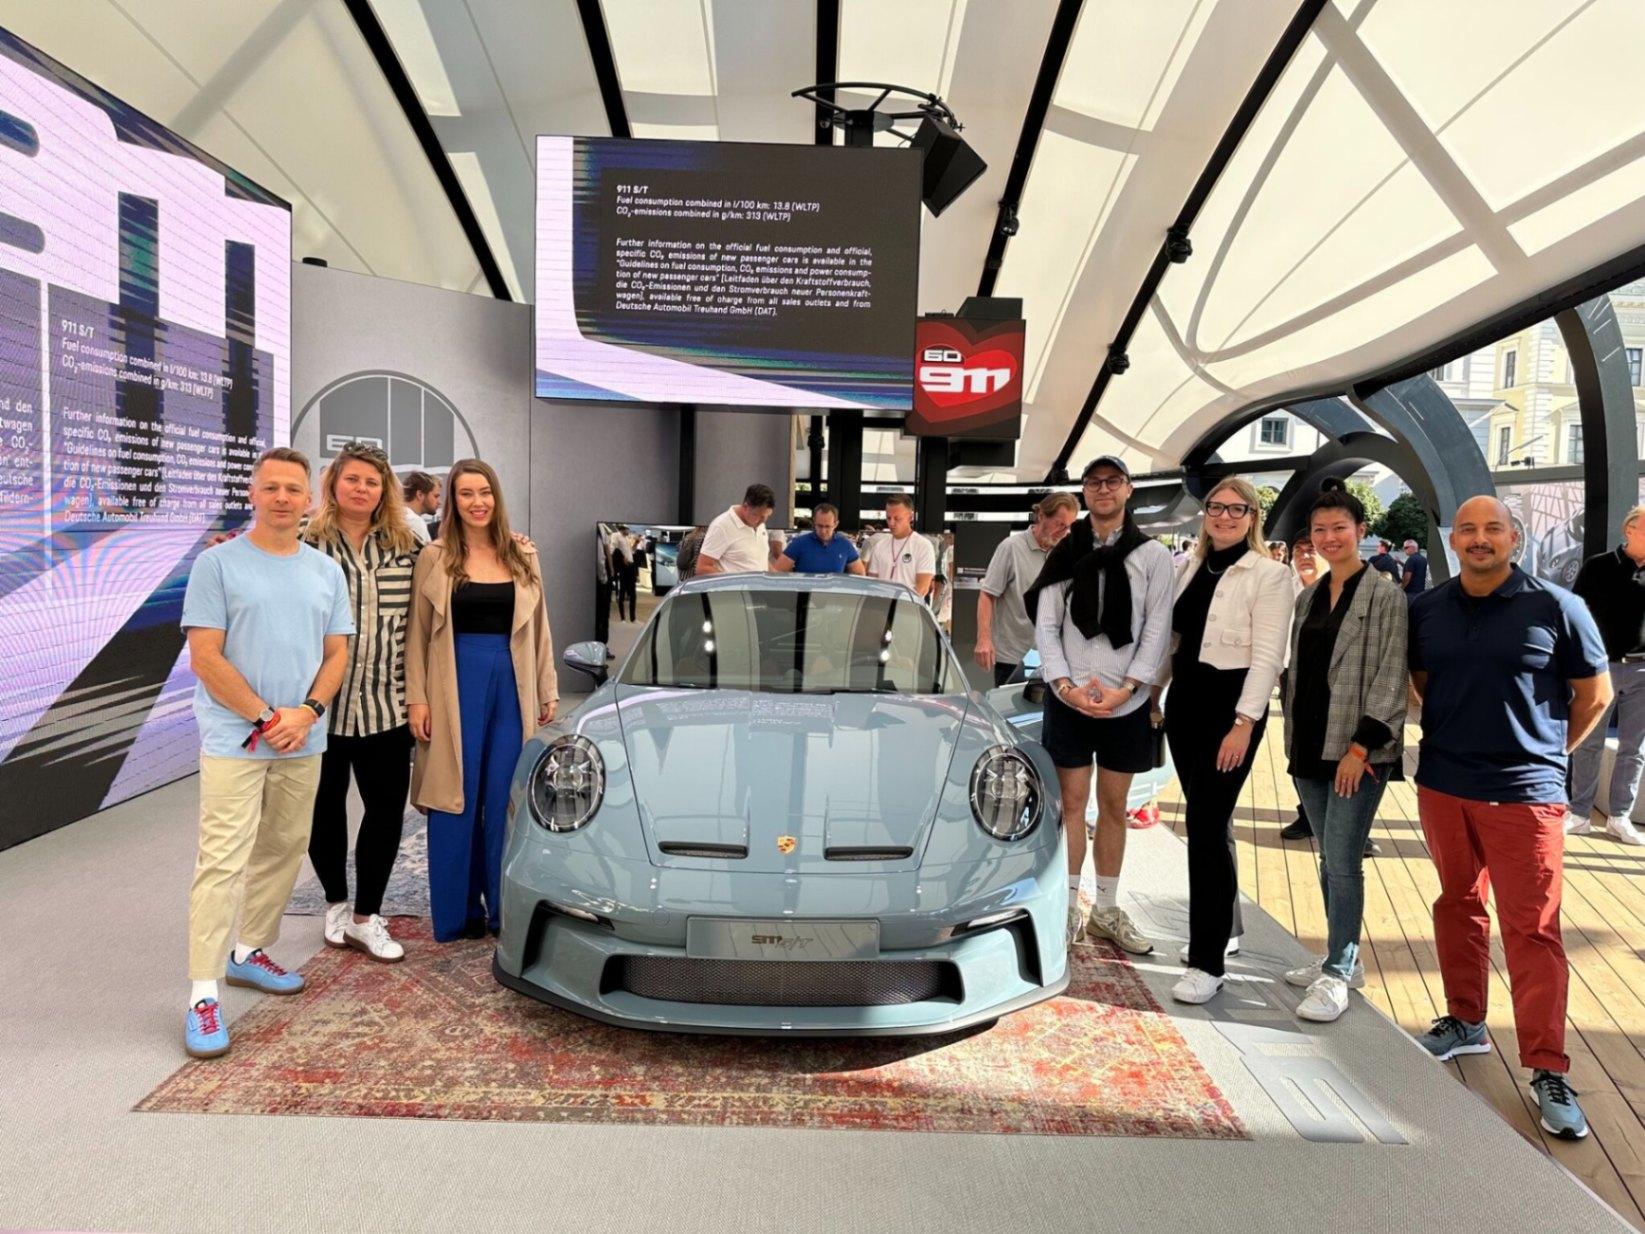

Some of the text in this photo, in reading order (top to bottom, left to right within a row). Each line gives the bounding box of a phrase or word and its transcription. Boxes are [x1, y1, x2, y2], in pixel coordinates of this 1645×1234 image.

[616, 184, 649, 194] 911 S/T
[616, 195, 633, 207] Fuel
[634, 197, 683, 208] consumption
[685, 198, 723, 208] combined
[724, 200, 731, 208] in
[732, 200, 755, 209] l/100
[673, 209, 712, 218] combined
[712, 210, 719, 218] in
[746, 211, 761, 220] 313
[616, 237, 645, 247] Further
[648, 238, 692, 249] information
[709, 242, 722, 251] the
[725, 242, 753, 251] official
[755, 243, 771, 252] fuel
[774, 245, 823, 255] consumption
[826, 246, 841, 255] and
[616, 249, 646, 258] specific
[668, 251, 706, 261] emissions
[709, 252, 718, 261] of
[739, 255, 779, 265] passenger
[802, 256, 809, 264] is
[812, 257, 845, 265] available
[849, 257, 856, 267] in
[860, 258, 872, 266] the
[671, 261, 687, 270] fuel
[755, 263, 793, 274] emissions
[794, 266, 809, 275] and
[809, 268, 833, 276] power
[834, 266, 872, 278] consump-
[616, 270, 631, 278] tion
[632, 270, 642, 281] of
[642, 272, 659, 280] new
[659, 273, 699, 283] passenger
[761, 276, 779, 284] über
[779, 276, 794, 285] den
[694, 283, 709, 292] und
[711, 285, 726, 293] den
[728, 284, 788, 295] Stromverbrauch
[791, 288, 813, 296] neuer
[815, 288, 871, 298] Personenkraft-
[649, 292, 682, 302] available
[686, 293, 702, 302] free
[705, 294, 714, 303] of
[717, 295, 743, 305] charge
[747, 296, 765, 304] from
[768, 297, 778, 305] all
[781, 297, 801, 306] sales
[804, 299, 831, 307] outlets
[835, 299, 850, 307] and
[853, 299, 871, 308] from
[615, 301, 652, 311] Deutsche
[652, 302, 692, 312] Automobil
[693, 304, 729, 314] Treuhand
[729, 305, 753, 315] GmbH
[61, 320, 77, 334] 911
[62, 337, 79, 352] Fuel
[80, 344, 128, 363] consumption
[920, 366, 1011, 394] 911
[63, 407, 92, 422] Further
